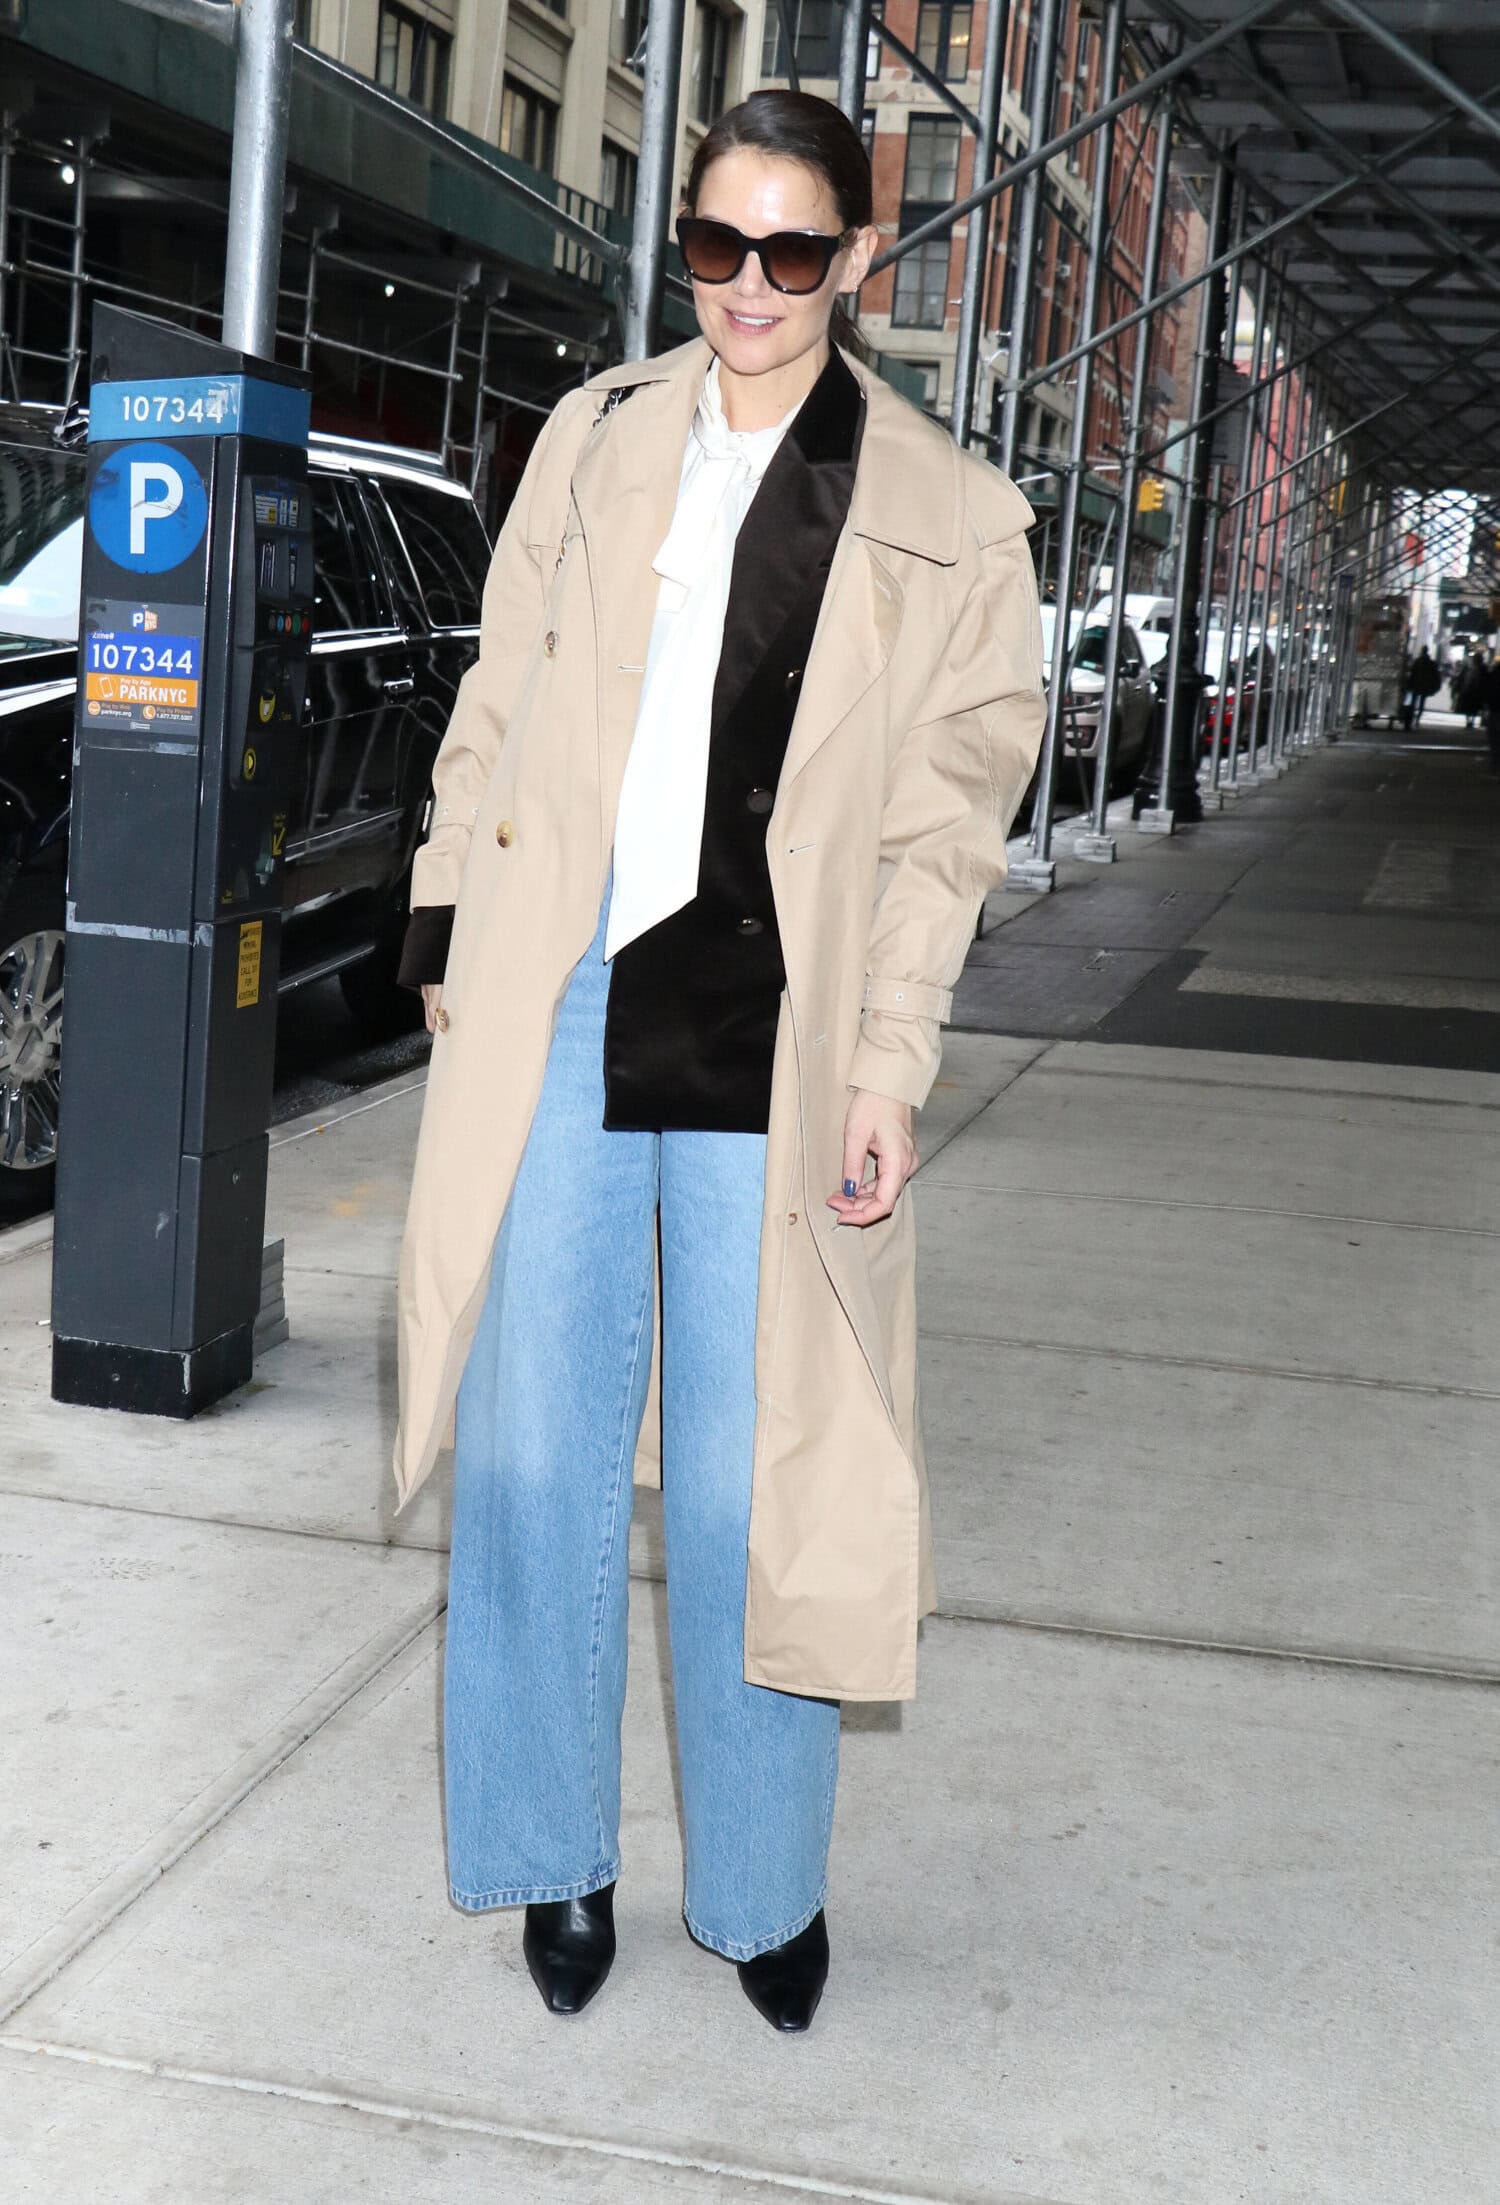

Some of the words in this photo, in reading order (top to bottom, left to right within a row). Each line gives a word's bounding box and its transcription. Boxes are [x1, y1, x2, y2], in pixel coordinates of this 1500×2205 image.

[123, 395, 224, 424] 107344
[130, 462, 184, 554] P
[92, 643, 193, 674] 107344
[119, 685, 187, 704] PARKNYC
